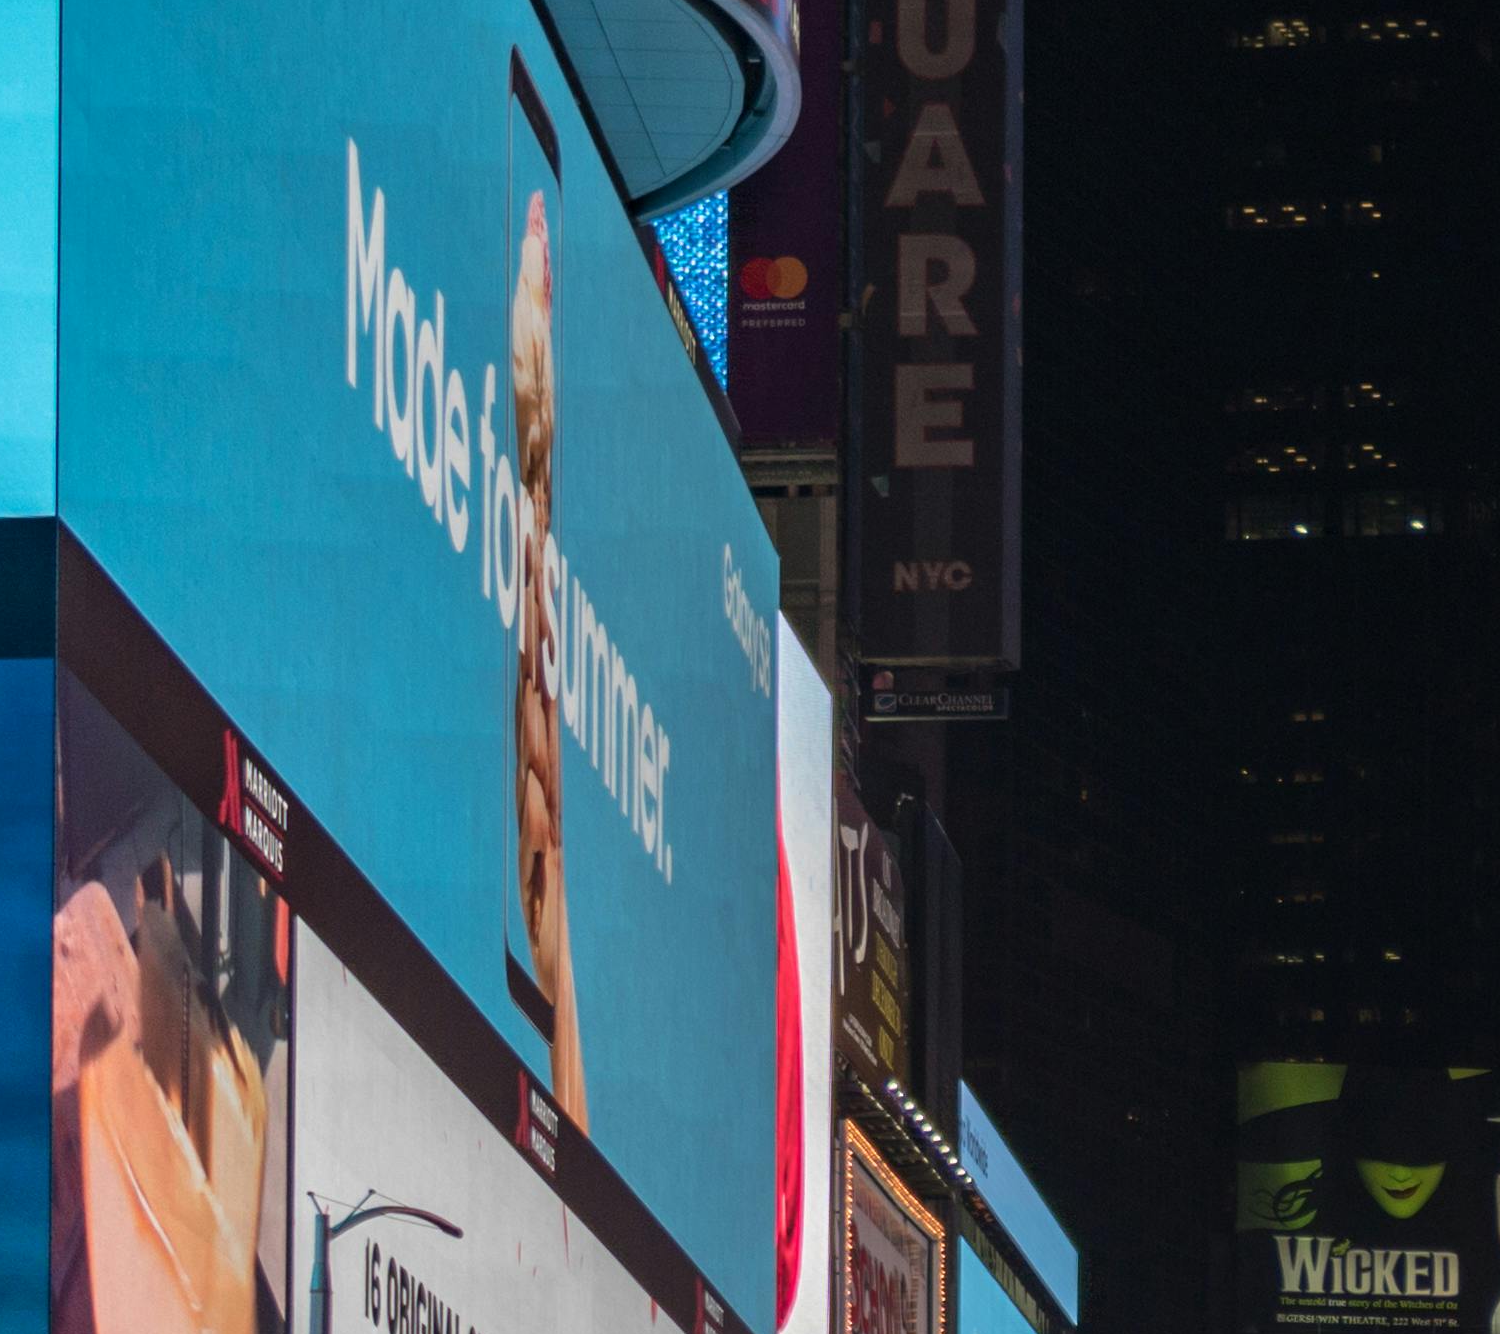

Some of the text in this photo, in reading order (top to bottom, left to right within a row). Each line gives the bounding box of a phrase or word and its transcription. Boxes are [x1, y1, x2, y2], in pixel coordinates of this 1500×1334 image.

[741, 318, 806, 329] PREFERRED
[742, 300, 806, 312] mastercard
[347, 136, 673, 885] Made for summer.
[894, 559, 973, 593] NYC
[244, 758, 289, 832] MARRIOTT
[244, 804, 285, 874] MARQUIS
[365, 1236, 381, 1328] 16
[1327, 1298, 1347, 1308] true
[1348, 1299, 1371, 1310] story
[1399, 1299, 1434, 1310] Witches
